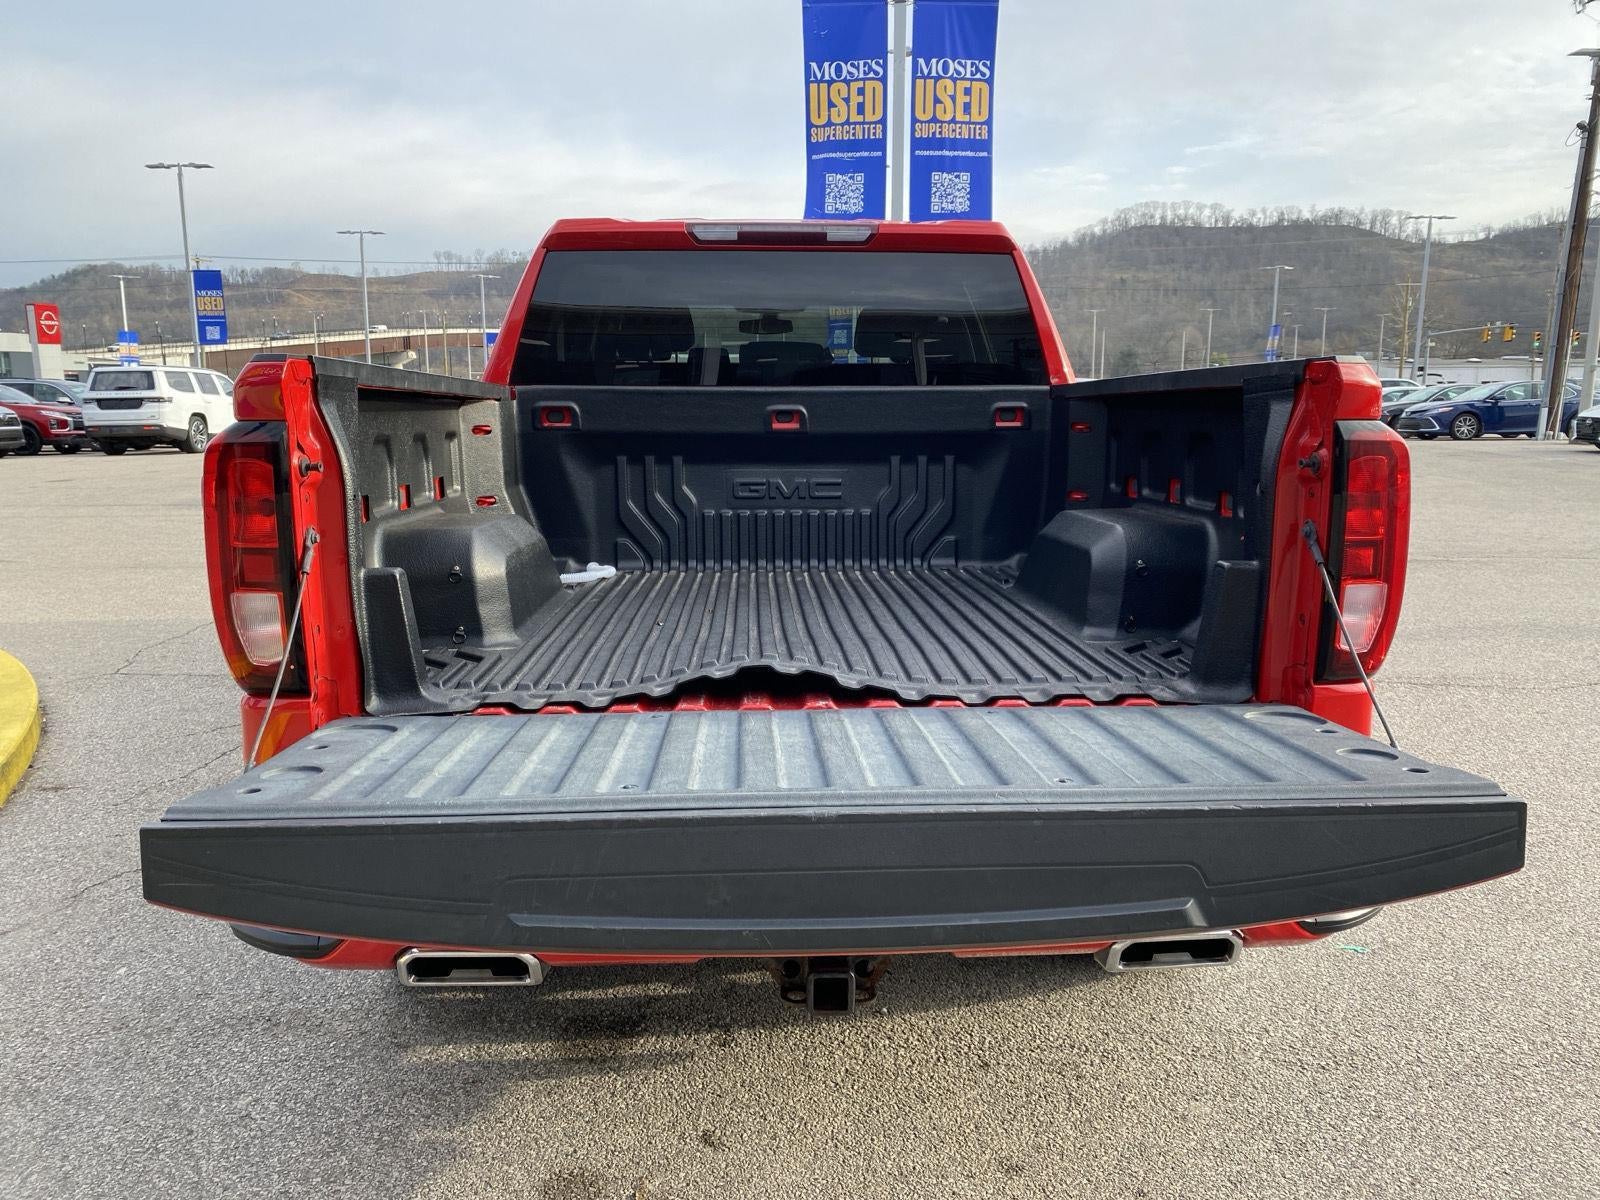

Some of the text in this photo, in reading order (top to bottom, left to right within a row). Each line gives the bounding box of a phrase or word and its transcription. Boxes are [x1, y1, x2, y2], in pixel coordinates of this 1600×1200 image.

[809, 59, 883, 81] MOSES
[917, 58, 990, 79] MOSES
[809, 80, 883, 126] USED
[915, 78, 989, 122] USED
[811, 124, 882, 143] SUPERCENTER
[915, 123, 988, 139] SUPERCENTER
[812, 151, 882, 160] mosesusedsupercenter.com
[915, 149, 988, 157] mosesusedsupercenter.com
[197, 296, 224, 311] USED
[733, 478, 842, 500] GMC
